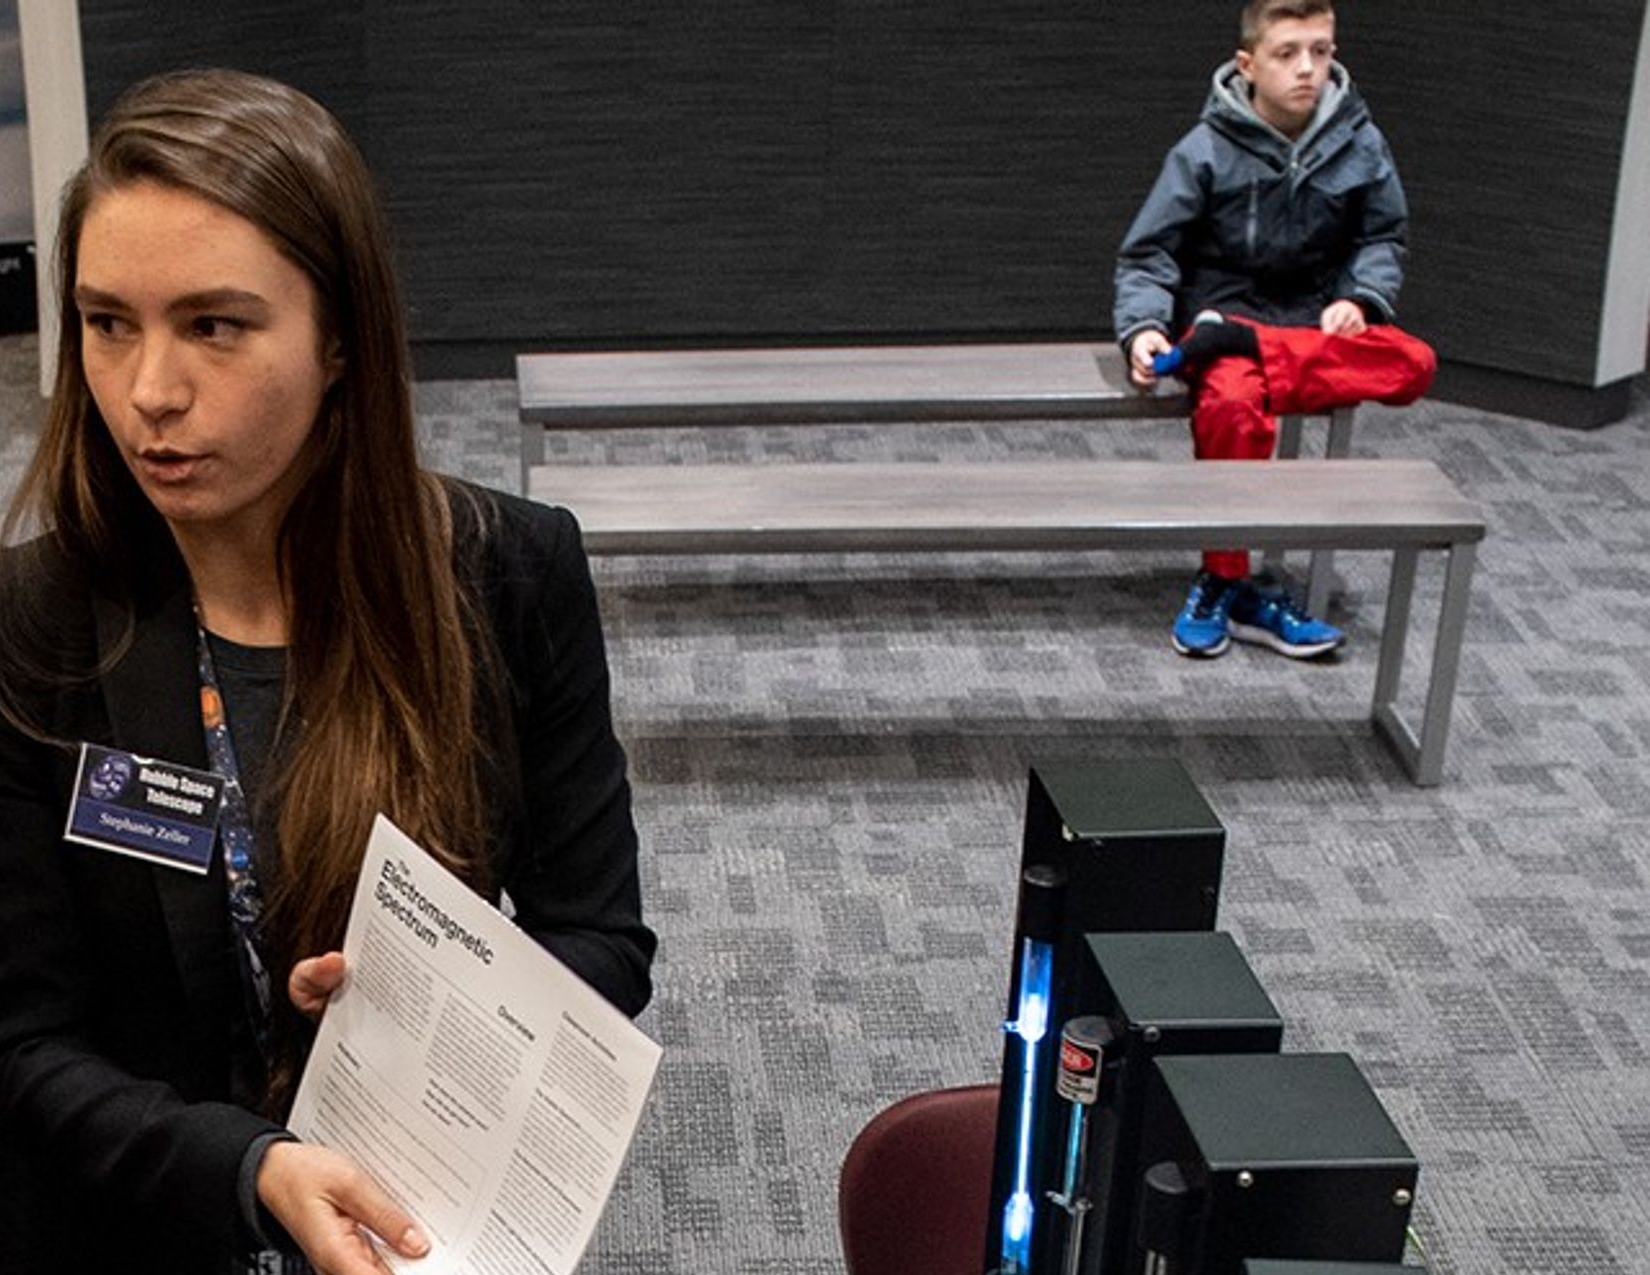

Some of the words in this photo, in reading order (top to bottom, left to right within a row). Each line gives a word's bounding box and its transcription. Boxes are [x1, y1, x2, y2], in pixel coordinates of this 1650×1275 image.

[146, 786, 204, 815] Telescope
[180, 775, 216, 799] Space
[98, 811, 155, 838] Stephanie
[373, 880, 439, 949] Spectrum
[381, 858, 495, 966] Electromagnetic
